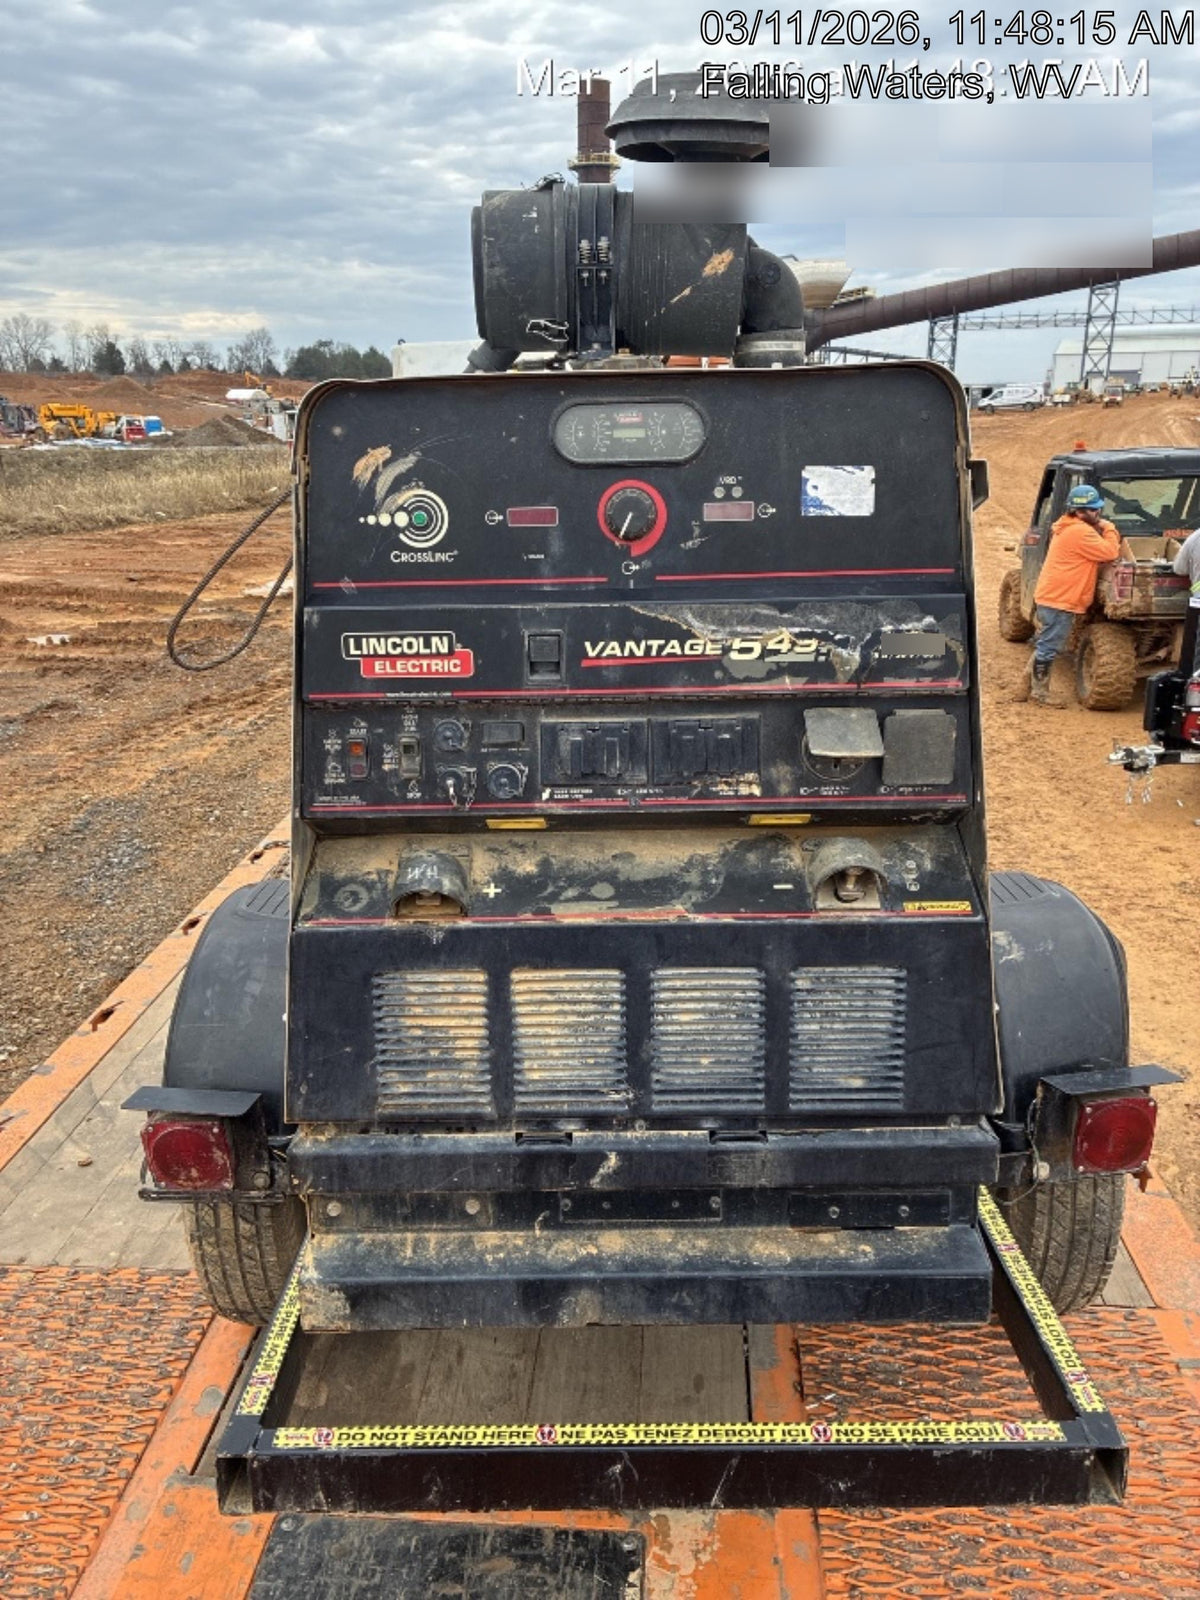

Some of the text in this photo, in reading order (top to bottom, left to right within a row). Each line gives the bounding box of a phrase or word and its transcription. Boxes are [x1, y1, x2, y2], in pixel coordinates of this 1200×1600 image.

[347, 635, 449, 655] LINCOLN
[583, 638, 722, 658] VANTAGE
[374, 659, 462, 673] ELECTRIC
[1025, 1282, 1052, 1321] STAND
[1045, 1321, 1065, 1348] NOT
[1060, 1350, 1077, 1369] DO
[336, 1430, 533, 1441] DO NOT STAND HERE
[560, 1428, 807, 1439] NE PAS TENEZ DEBOUT ICI
[835, 1428, 865, 1437] NO
[869, 1428, 894, 1438] SE
[898, 1427, 950, 1437] PARE
